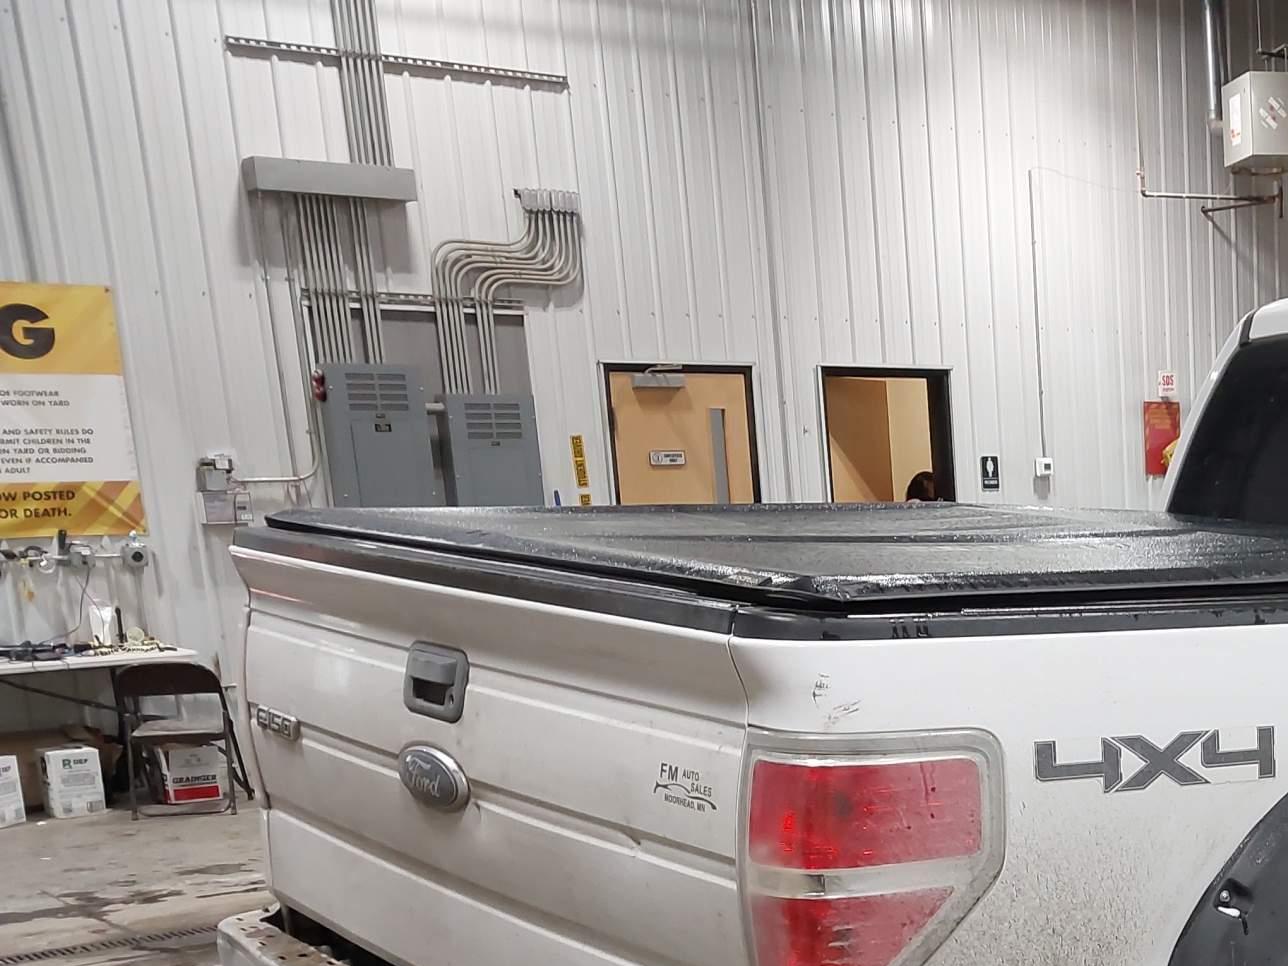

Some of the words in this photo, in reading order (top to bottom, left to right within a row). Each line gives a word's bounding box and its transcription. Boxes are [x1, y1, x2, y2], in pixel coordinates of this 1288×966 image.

[23, 490, 75, 501] POSTED
[23, 507, 72, 518] DEATH.
[1034, 725, 1276, 793] 4X4
[660, 762, 679, 782] FM
[681, 769, 700, 781] AUTO
[690, 782, 712, 798] SALES
